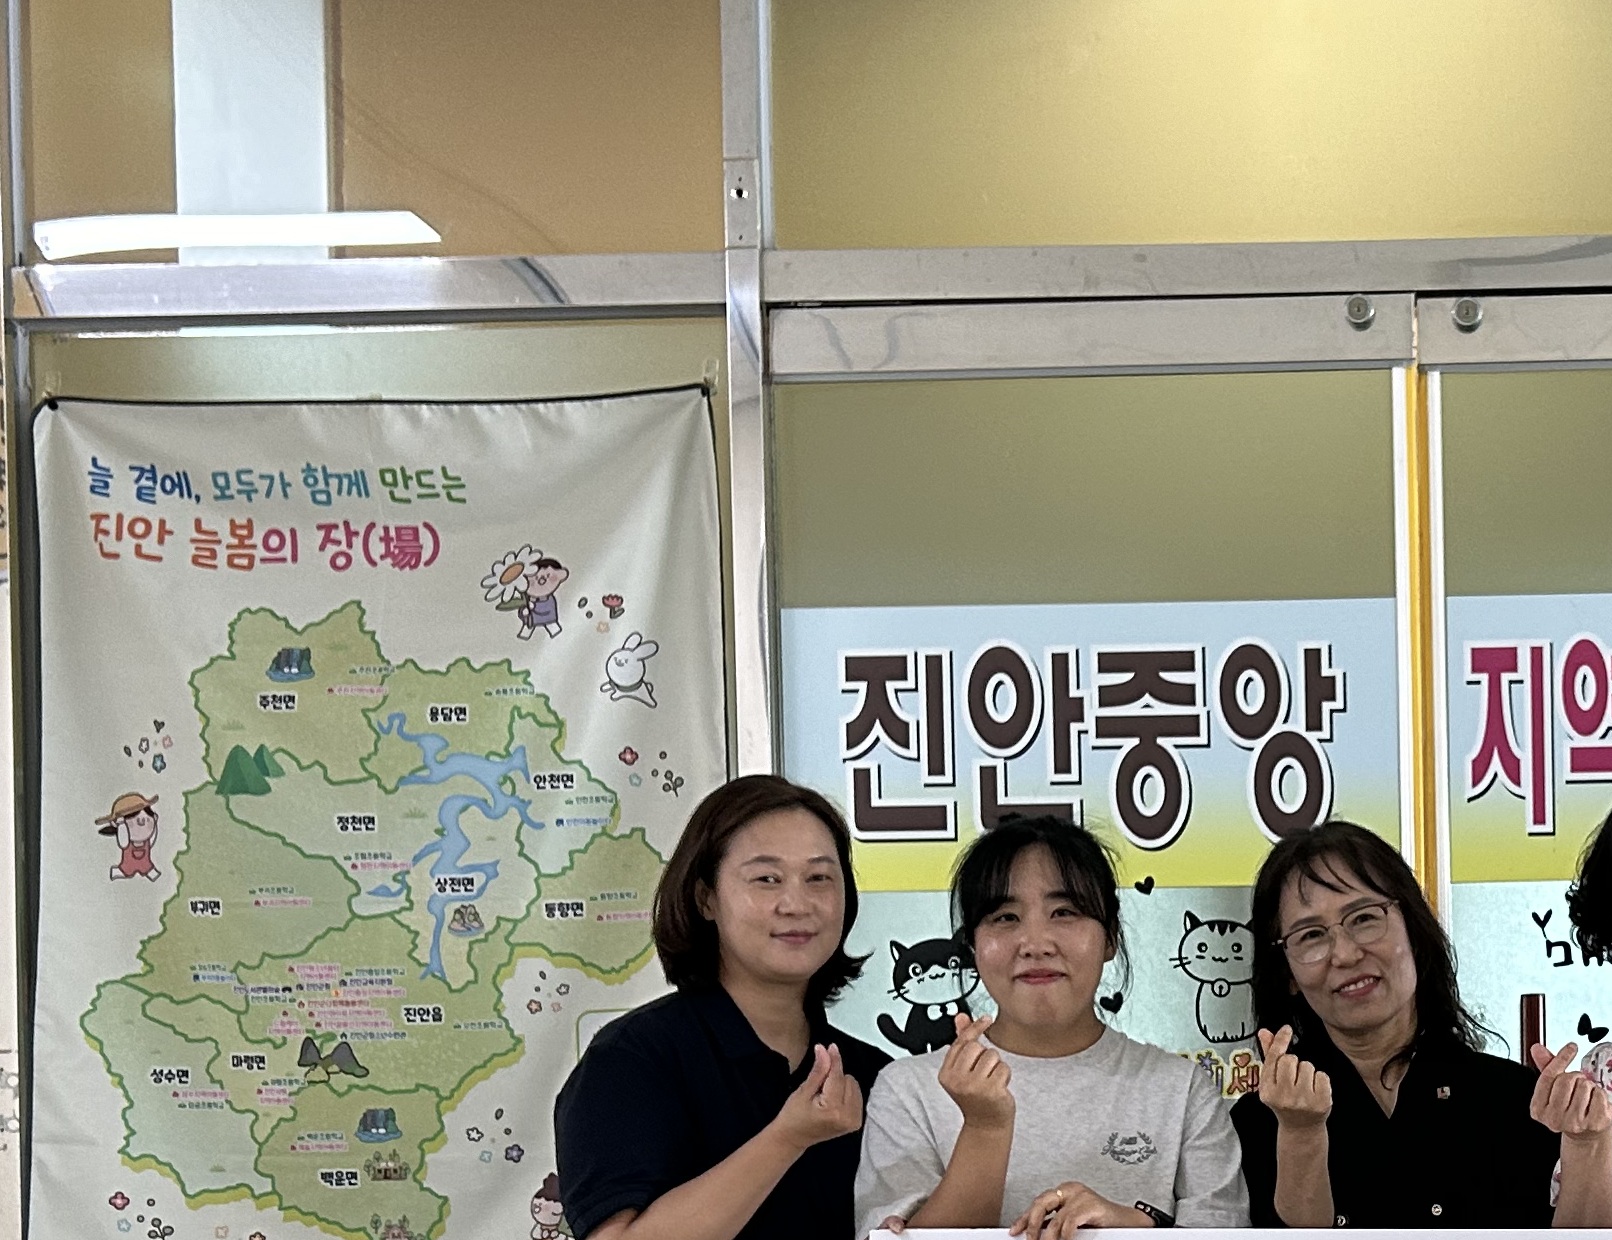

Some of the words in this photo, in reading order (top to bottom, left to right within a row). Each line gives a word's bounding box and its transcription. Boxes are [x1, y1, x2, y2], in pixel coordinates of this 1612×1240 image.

[87, 457, 113, 498] 늘
[132, 464, 201, 504] 곁에,
[211, 468, 290, 503] 모두가
[302, 463, 369, 505] 함께
[380, 465, 466, 503] 만드는
[90, 513, 173, 561] 진안
[189, 518, 299, 571] 늘봄의
[318, 521, 441, 571] 장(場)
[257, 691, 297, 711] 주천면
[429, 706, 467, 722] 용담면
[841, 639, 1344, 848] 진안중앙
[533, 773, 574, 790] 안천면
[337, 815, 375, 831] 정천면
[435, 877, 474, 893] 상전면
[190, 900, 221, 916] 부귀면
[545, 902, 584, 918] 동향면
[403, 1006, 443, 1022] 진안읍
[231, 1055, 266, 1070] 마령면
[150, 1069, 190, 1084] 성수면
[320, 1171, 358, 1186] 백운면
